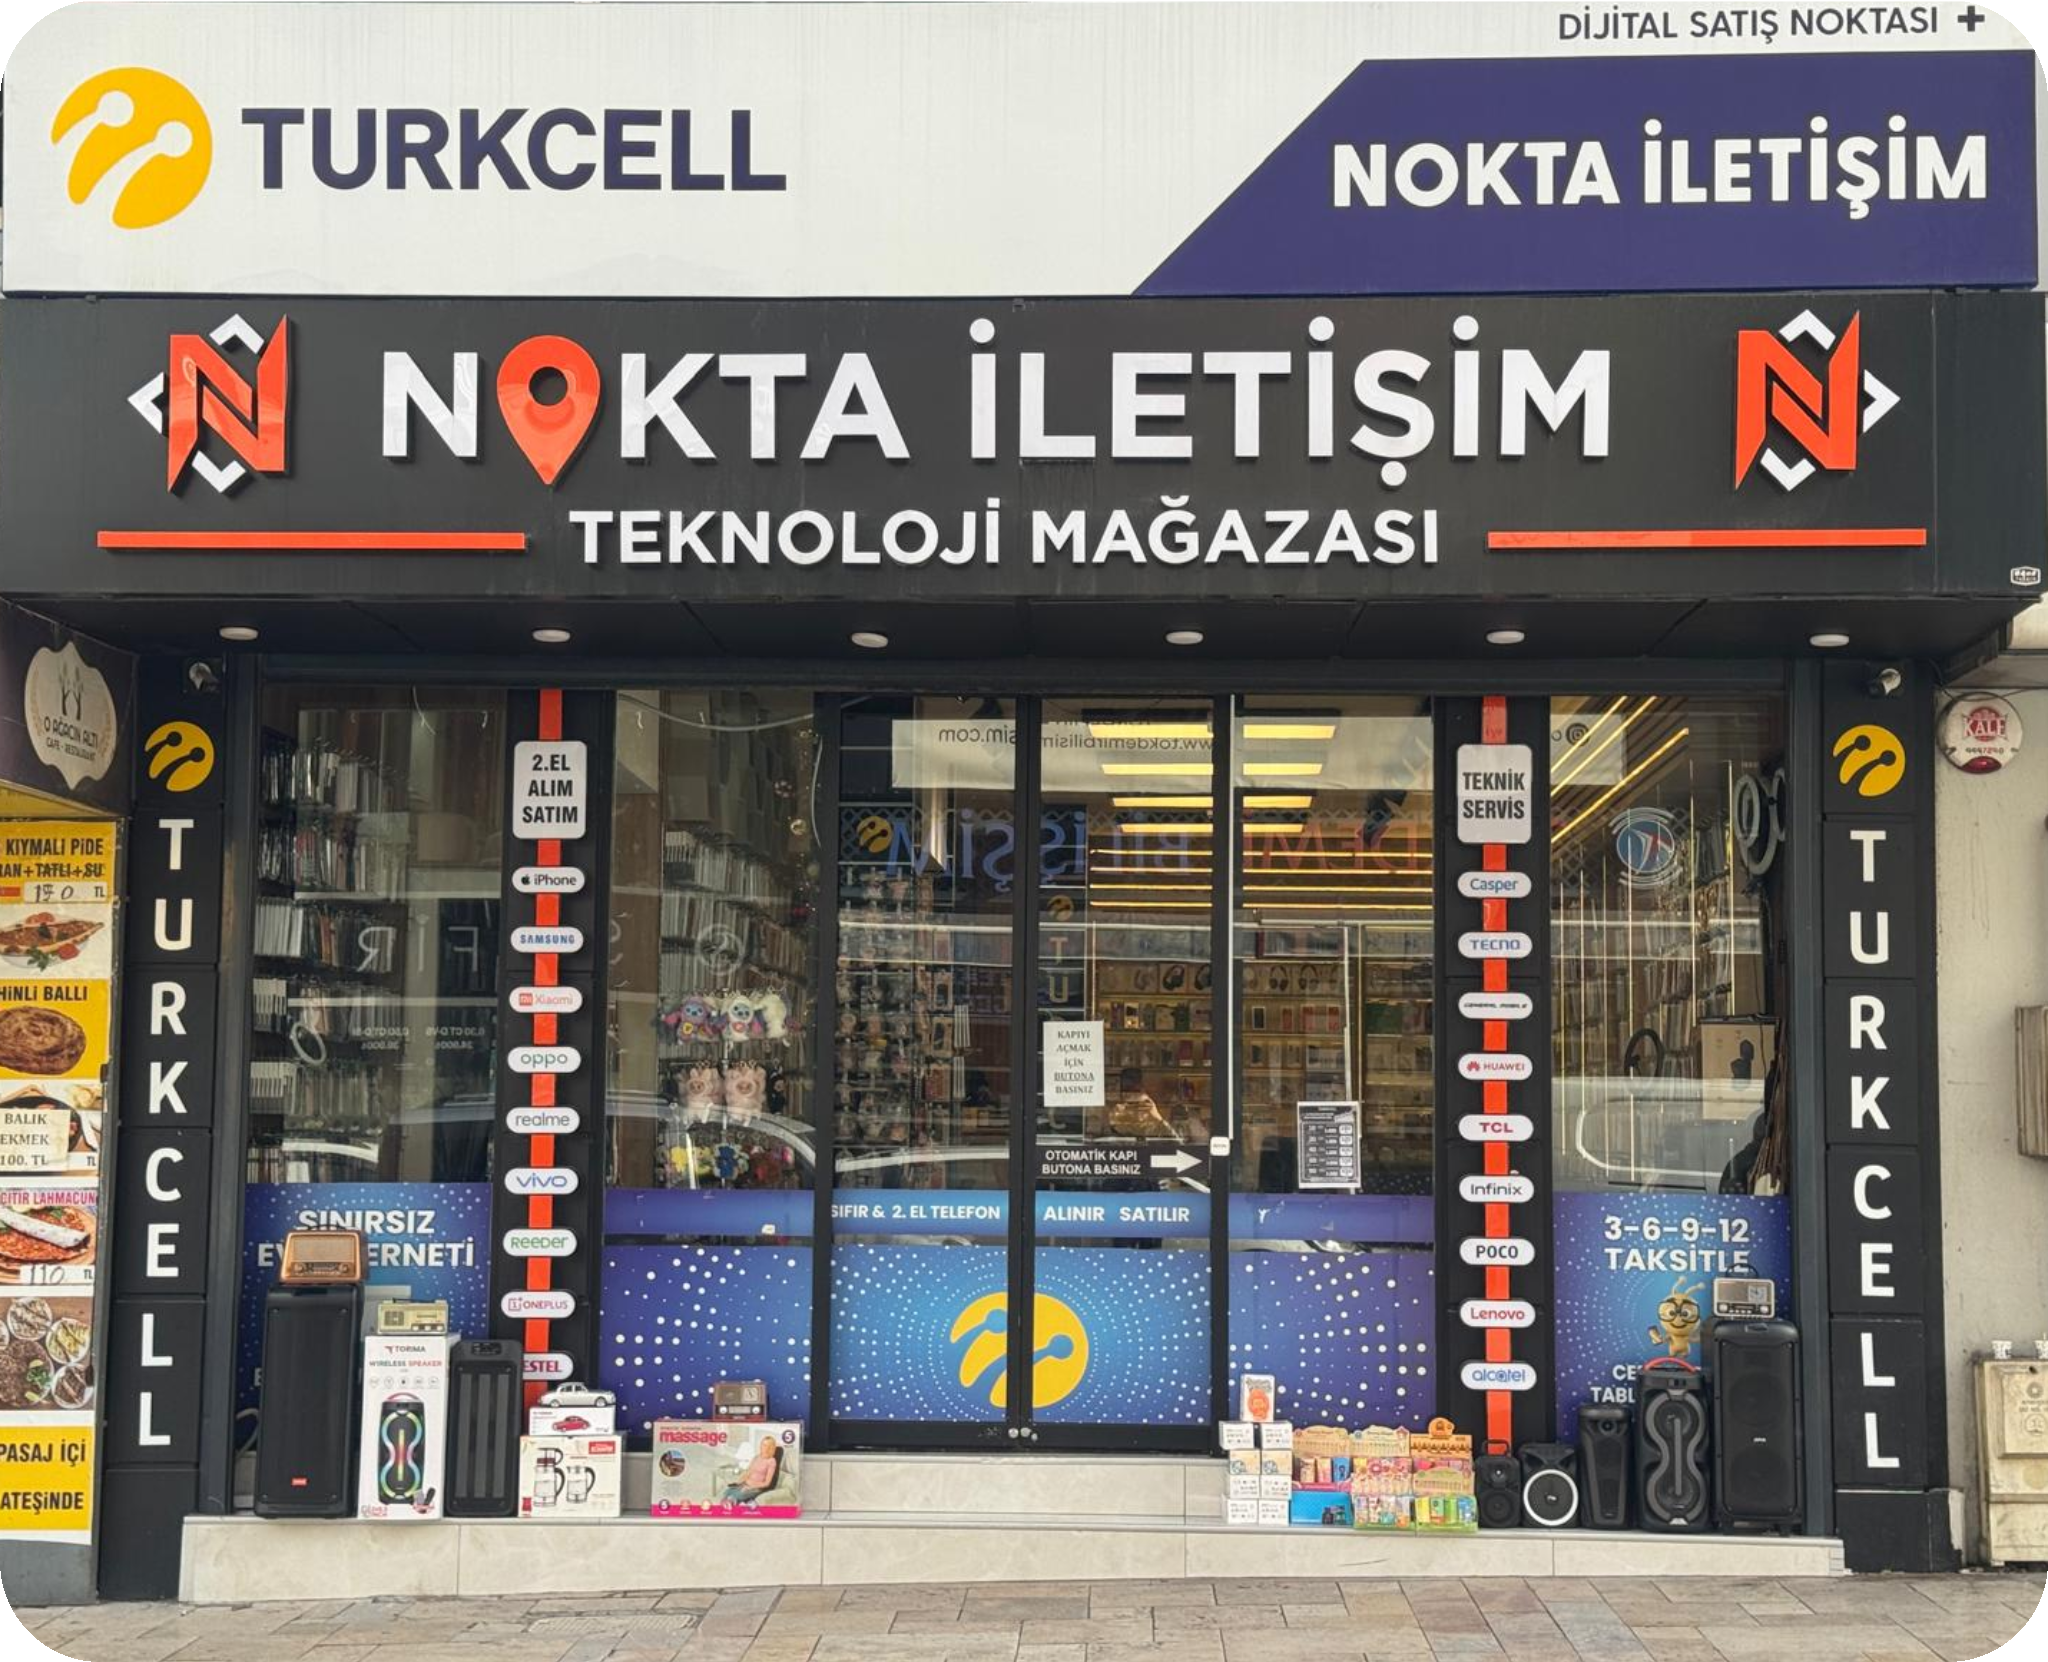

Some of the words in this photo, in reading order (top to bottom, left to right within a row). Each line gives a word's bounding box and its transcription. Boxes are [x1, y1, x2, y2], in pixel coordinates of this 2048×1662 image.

[1558, 5, 1680, 40] DİJİTAL
[1690, 7, 1779, 44] SATIŞ
[1790, 5, 1938, 38] NOKTASI
[242, 108, 786, 191] TURKCELL
[1333, 141, 1620, 207] NOKTA
[1644, 116, 1986, 219] İLETİŞİM
[970, 314, 1610, 487] İLETİŞİM
[569, 497, 1000, 564] TEKNOLOJİ
[1032, 495, 1438, 564] MAĞAZASI
[532, 754, 570, 771] 2.EL
[1463, 769, 1524, 791] TEKNİK
[528, 780, 573, 797] ALIM
[522, 806, 578, 823] SATIM
[1463, 796, 1524, 819] SERVİS
[6, 838, 65, 855] KIYMALI
[534, 874, 577, 887] iPhone
[1470, 878, 1518, 894] Casper
[94, 886, 105, 897] TL
[520, 934, 575, 944] SAMSUNG
[1470, 939, 1520, 950] TECNO
[44, 986, 87, 1000] BALLI
[534, 993, 573, 1005] Xiaomi
[1057, 1031, 1090, 1039] KAPIYI
[1056, 1044, 1091, 1054] AÇMAK
[521, 1053, 568, 1069] oppo
[1064, 1057, 1084, 1068] İÇİN
[1483, 1062, 1525, 1071] HUAWEI
[1054, 1072, 1095, 1082] BUTONA
[1055, 1086, 1093, 1094] BASINIZ
[5, 1113, 48, 1125] BALIK
[516, 1112, 570, 1126] realme
[138, 819, 195, 1446] TURKCELL
[1479, 1122, 1513, 1134] TCL
[0, 1134, 50, 1145] EKMEK
[1045, 1148, 1106, 1161] OTOMATİK
[1109, 1150, 1137, 1161] KAPI
[1849, 829, 1900, 1468] TURKCELL
[31, 1155, 48, 1165] TL
[1042, 1164, 1091, 1175] BUTONA
[1094, 1164, 1141, 1175] BASINIZ
[516, 1172, 568, 1188] vivo
[1471, 1184, 1522, 1196] Infinix
[34, 1192, 96, 1204] LAHMACUN
[831, 1205, 868, 1218] SIFIR
[892, 1206, 906, 1219] 2.
[910, 1206, 927, 1219] EL
[931, 1206, 1000, 1220] TELEFON
[1043, 1206, 1105, 1221] ALINIR
[1119, 1207, 1190, 1222] SATILIR
[297, 1210, 436, 1234] SINIRSIZ
[1604, 1215, 1750, 1243] 3-6-9-12
[1476, 1245, 1518, 1258] POCO
[1604, 1244, 1750, 1273] TAKSİTLE
[523, 1301, 568, 1309] ONEPLUS
[1470, 1307, 1524, 1320] Lenovo
[1472, 1367, 1525, 1383] alcatel
[660, 1431, 727, 1446] massage
[0, 1443, 53, 1463] PASAJ
[61, 1439, 86, 1467] İÇİ
